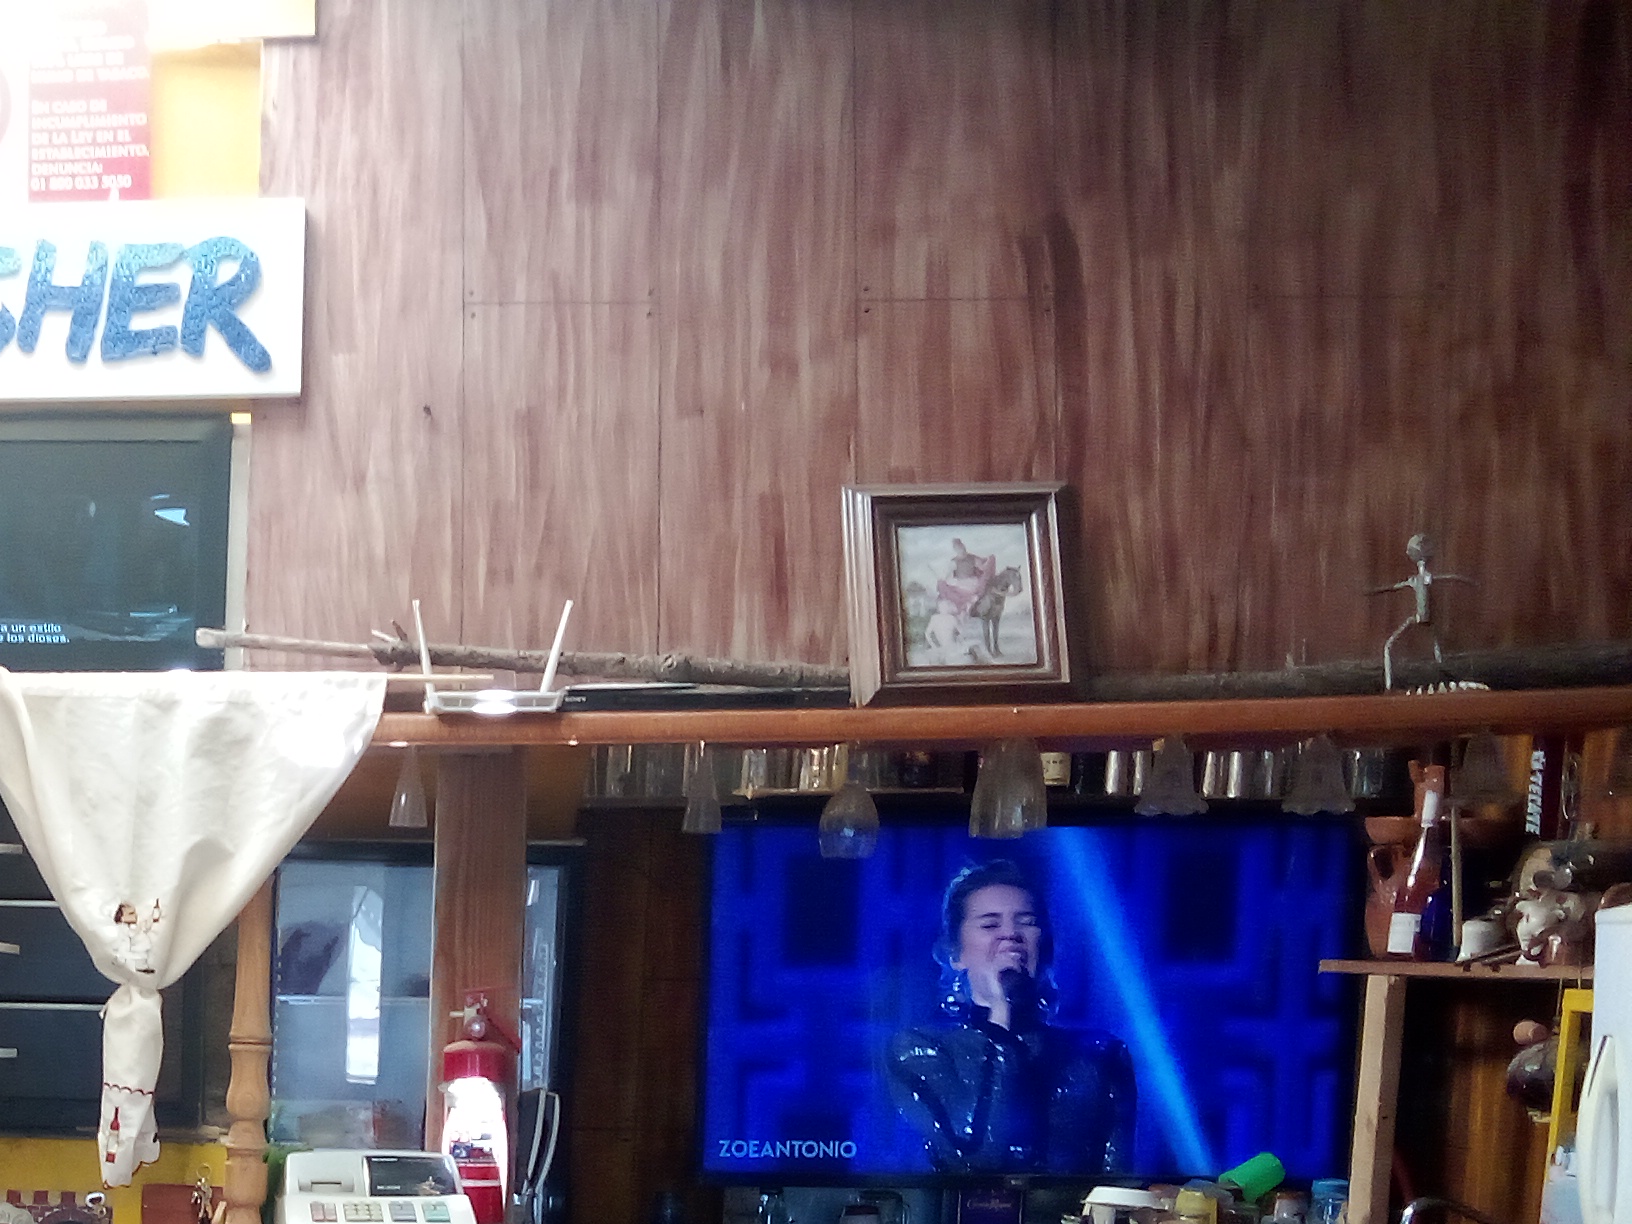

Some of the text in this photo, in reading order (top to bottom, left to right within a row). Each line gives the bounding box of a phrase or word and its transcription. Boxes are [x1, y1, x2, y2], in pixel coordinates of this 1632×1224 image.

[32, 129, 131, 145] DE LA LEY EN EL
[31, 177, 46, 191] 01
[1525, 770, 1543, 836] TECATE
[719, 1140, 858, 1159] ZOEANTONIO
